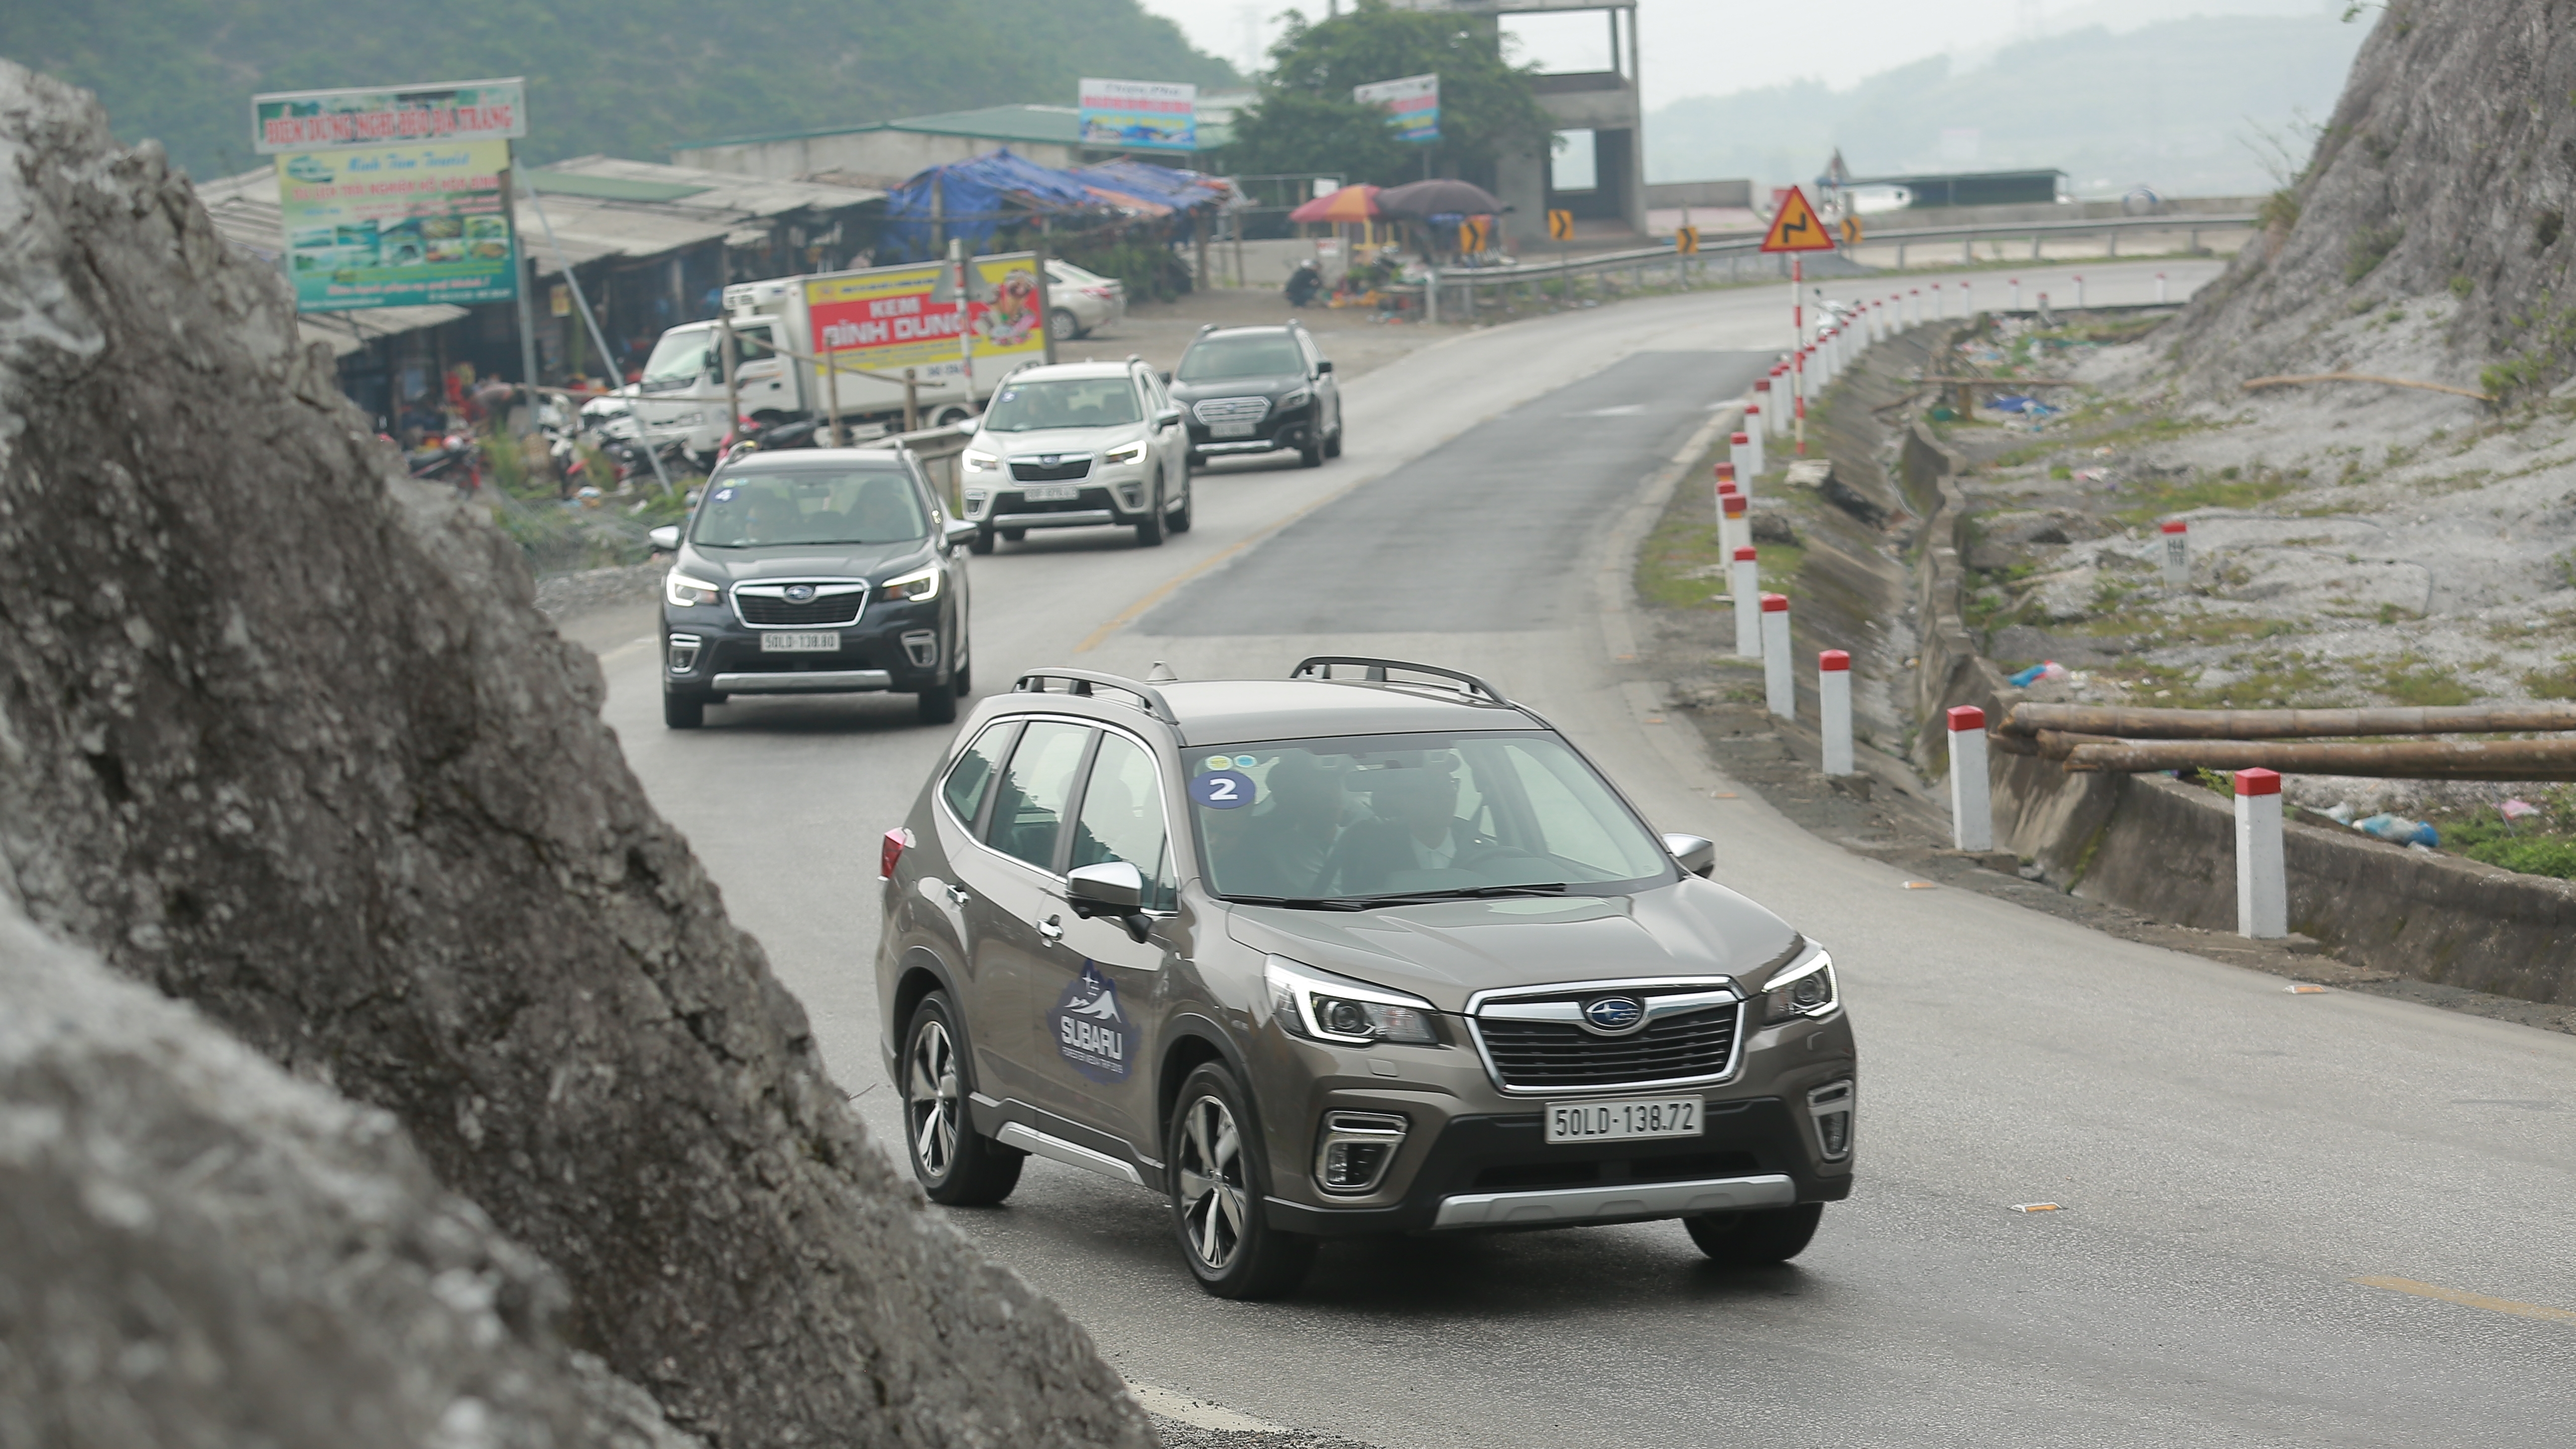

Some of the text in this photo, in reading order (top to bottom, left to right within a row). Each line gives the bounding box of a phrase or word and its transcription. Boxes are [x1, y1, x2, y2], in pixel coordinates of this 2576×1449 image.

[869, 297, 921, 318] KEM
[1209, 778, 1238, 801] 2
[1060, 1015, 1122, 1061] SUBARU
[1554, 1102, 1694, 1137] 50LD-138.72
